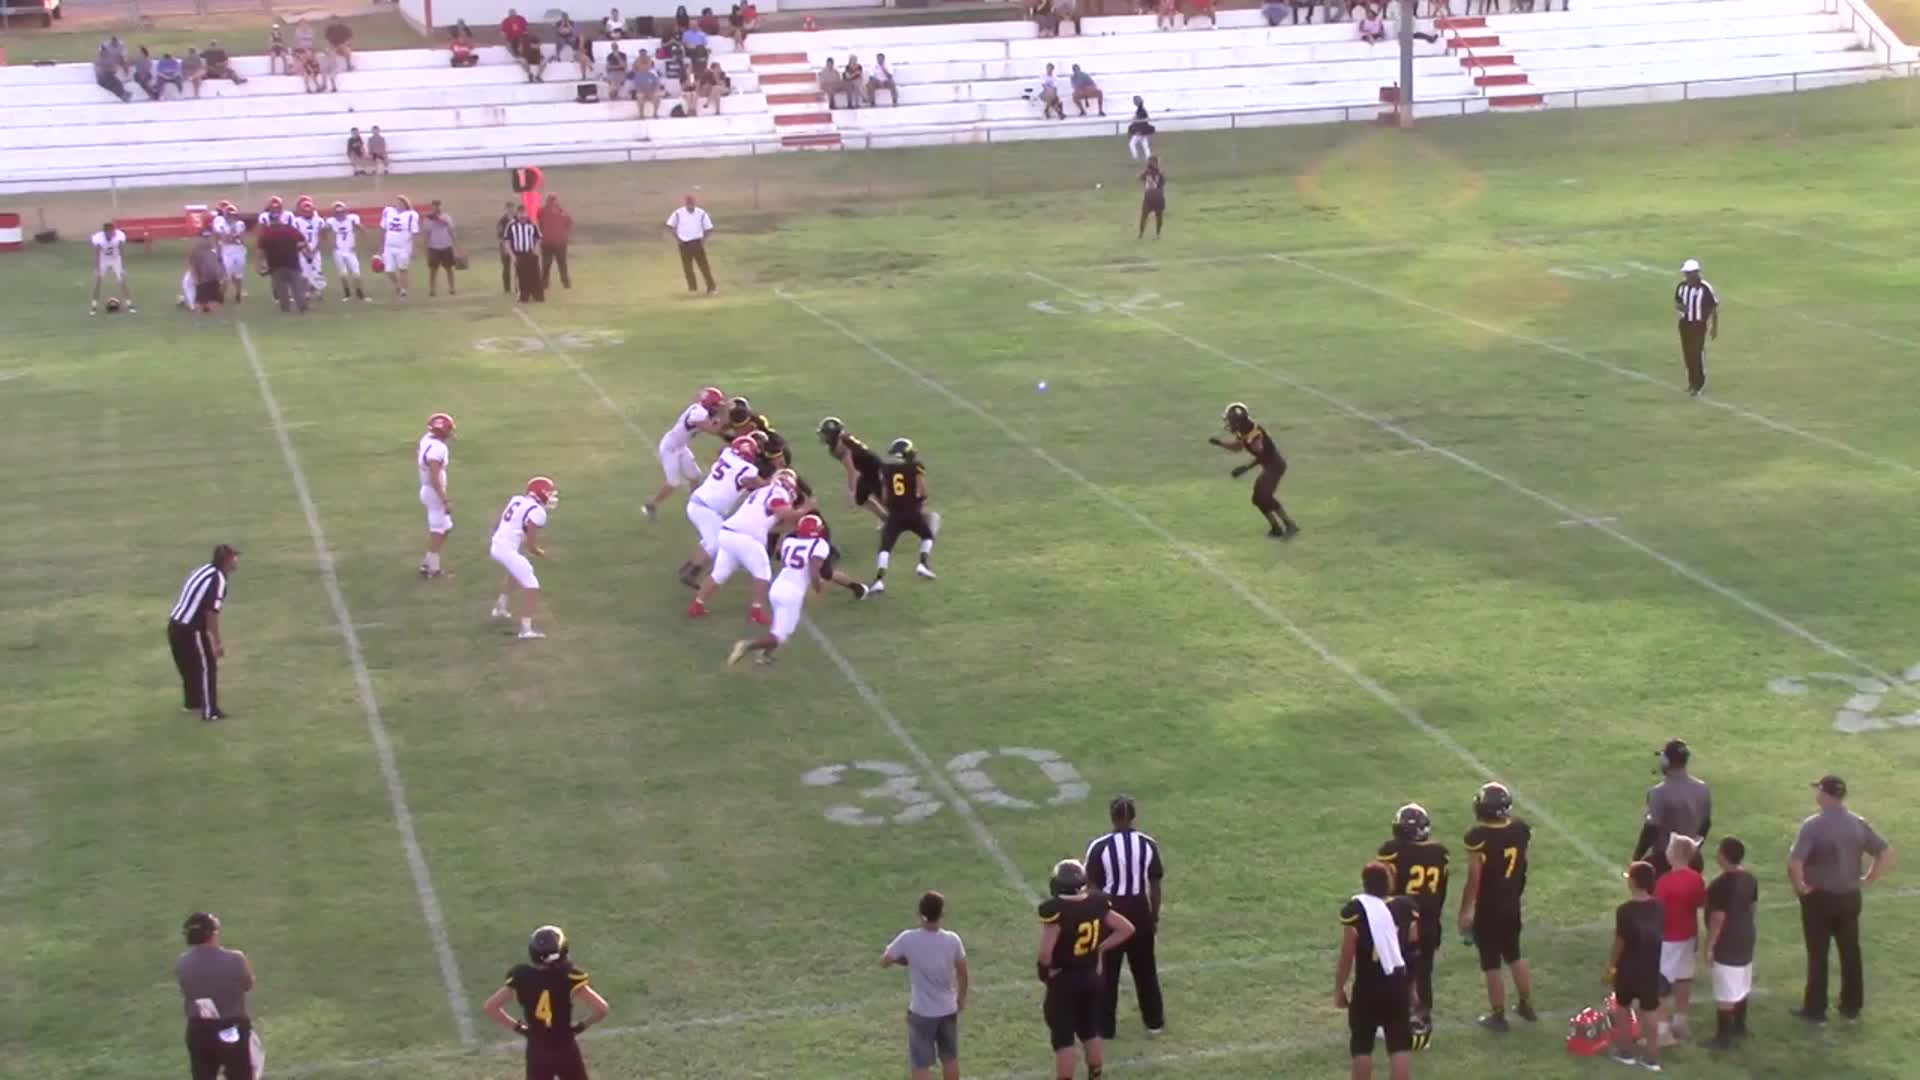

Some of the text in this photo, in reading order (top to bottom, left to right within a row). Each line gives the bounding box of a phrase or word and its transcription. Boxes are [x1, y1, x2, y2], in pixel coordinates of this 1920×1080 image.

[893, 473, 905, 496] 6
[783, 545, 807, 570] 15
[1766, 664, 1920, 734] 2
[801, 746, 1092, 826] 30
[1503, 847, 1518, 879] 7
[1073, 918, 1101, 957] 21
[535, 989, 553, 1028] 4
